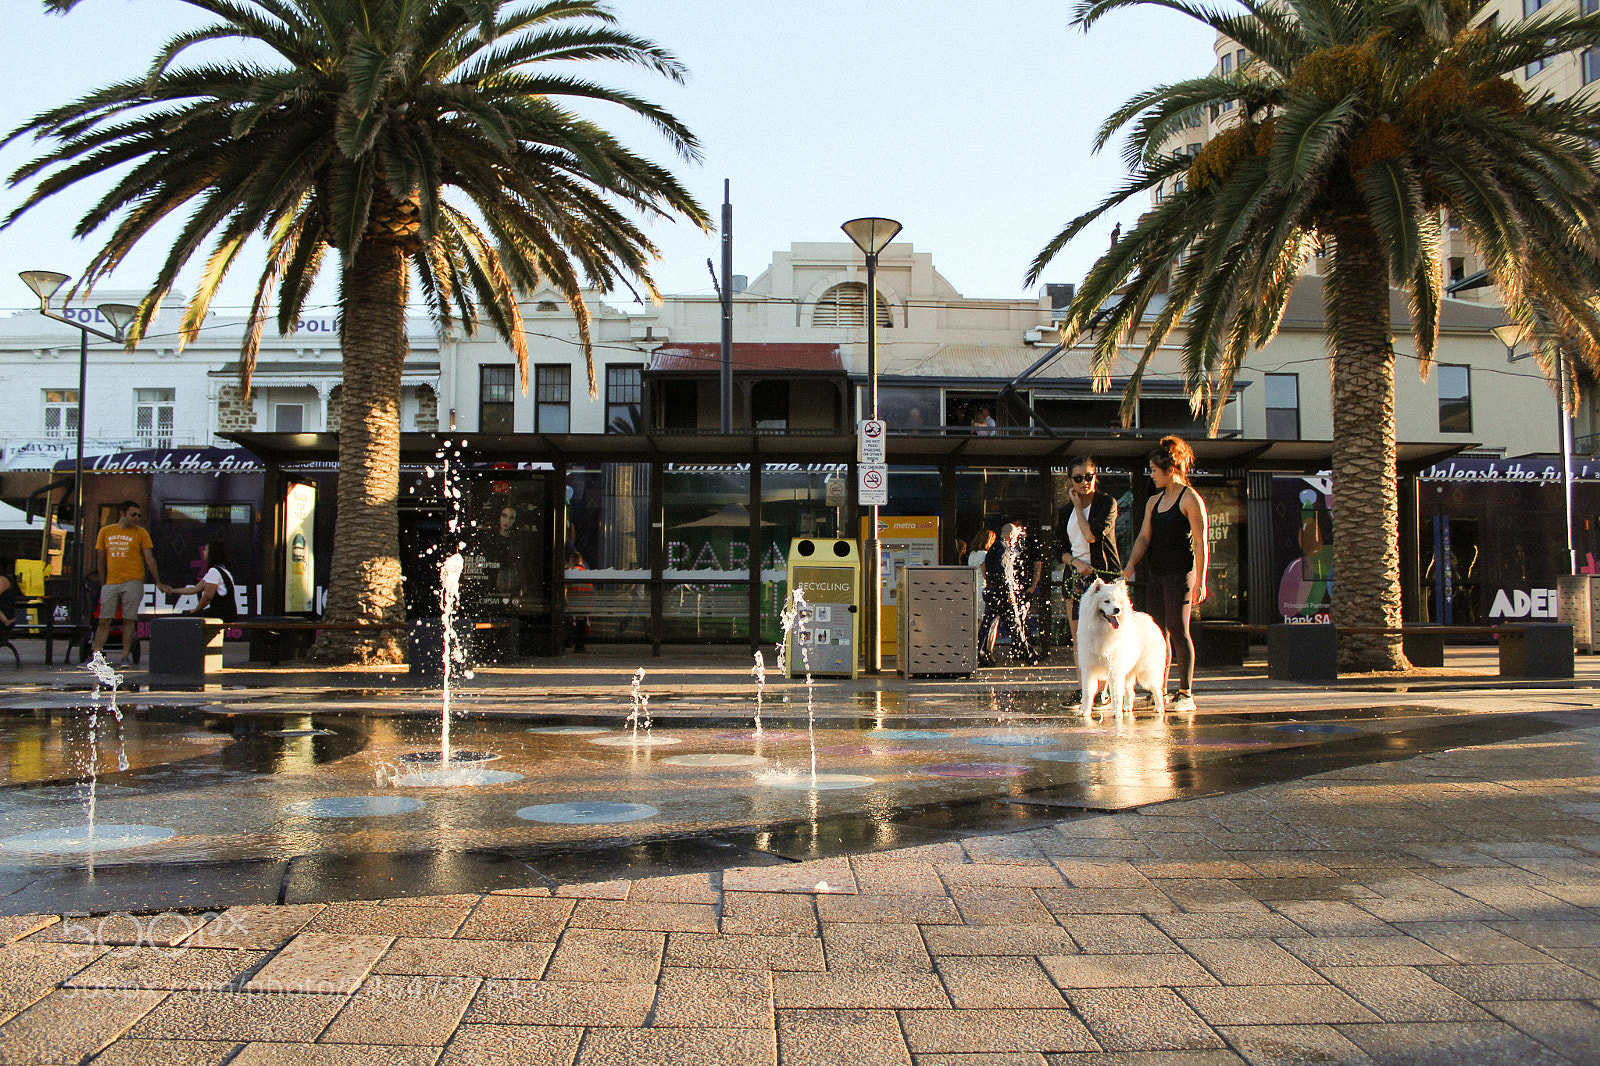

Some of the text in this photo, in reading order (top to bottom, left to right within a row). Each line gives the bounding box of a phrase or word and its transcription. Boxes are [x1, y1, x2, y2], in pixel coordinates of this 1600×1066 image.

[63, 308, 106, 324] POL
[295, 319, 337, 333] POLI
[92, 453, 175, 475] Unleash
[179, 453, 214, 474] the
[1505, 463, 1538, 482] the
[1208, 526, 1229, 541] RGY
[798, 582, 850, 592] RECYCLING
